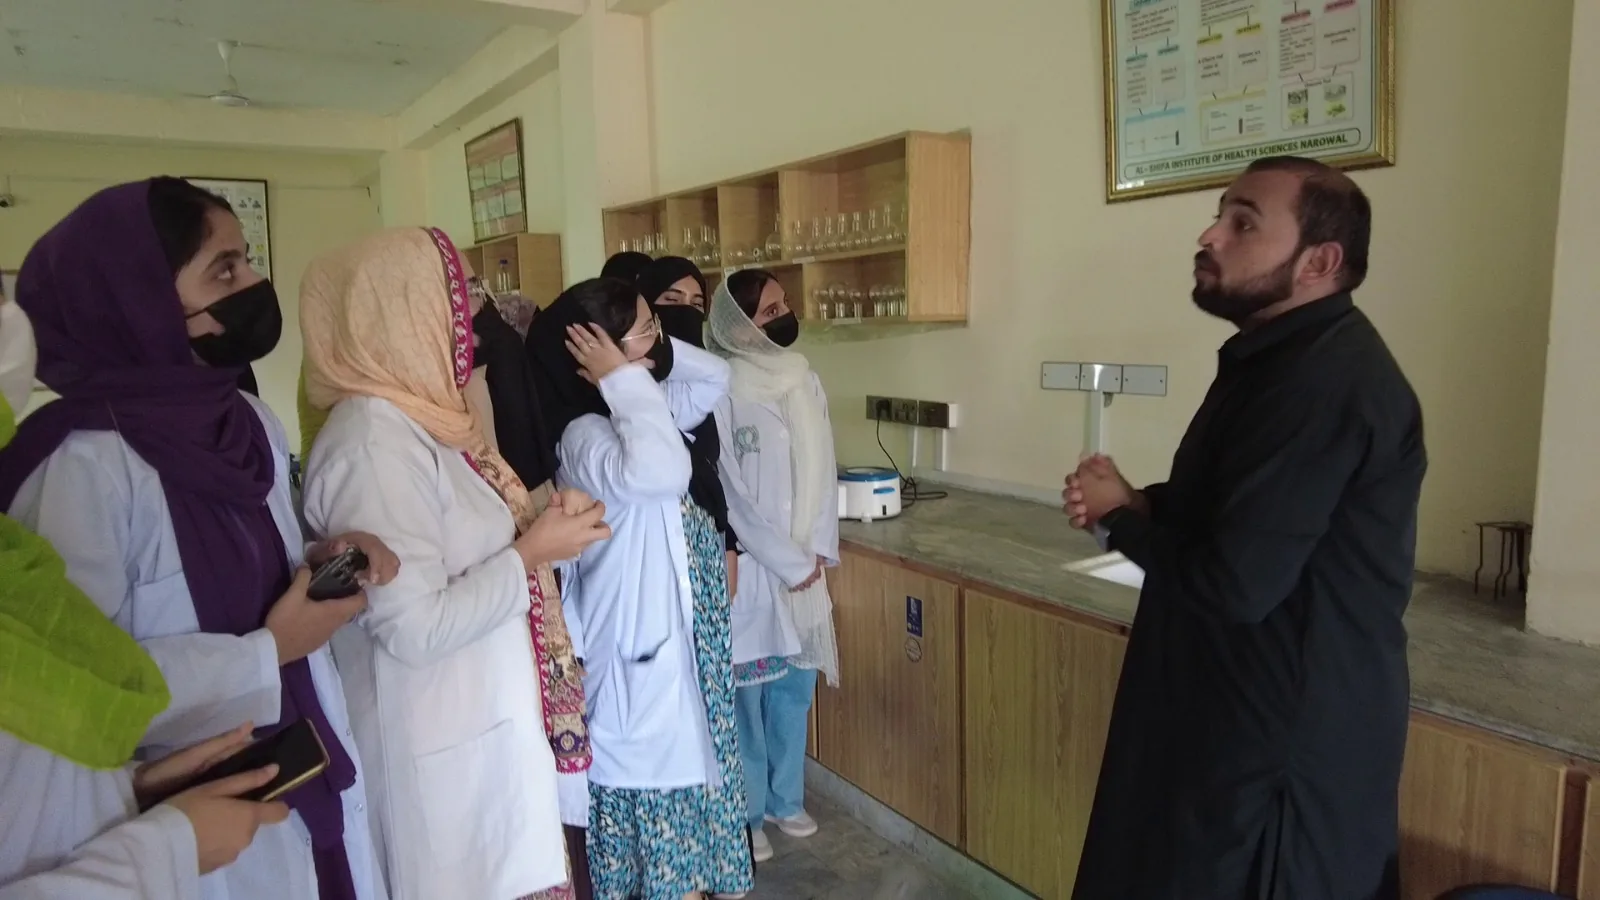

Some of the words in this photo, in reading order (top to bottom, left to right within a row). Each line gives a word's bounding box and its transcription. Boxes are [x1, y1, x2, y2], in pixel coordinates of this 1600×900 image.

[1171, 154, 1210, 168] INSTITUTE
[1212, 153, 1223, 163] OF
[1224, 148, 1257, 160] HEALTH
[1259, 141, 1298, 156] SCIENCES
[1300, 134, 1348, 149] NAROWAL
